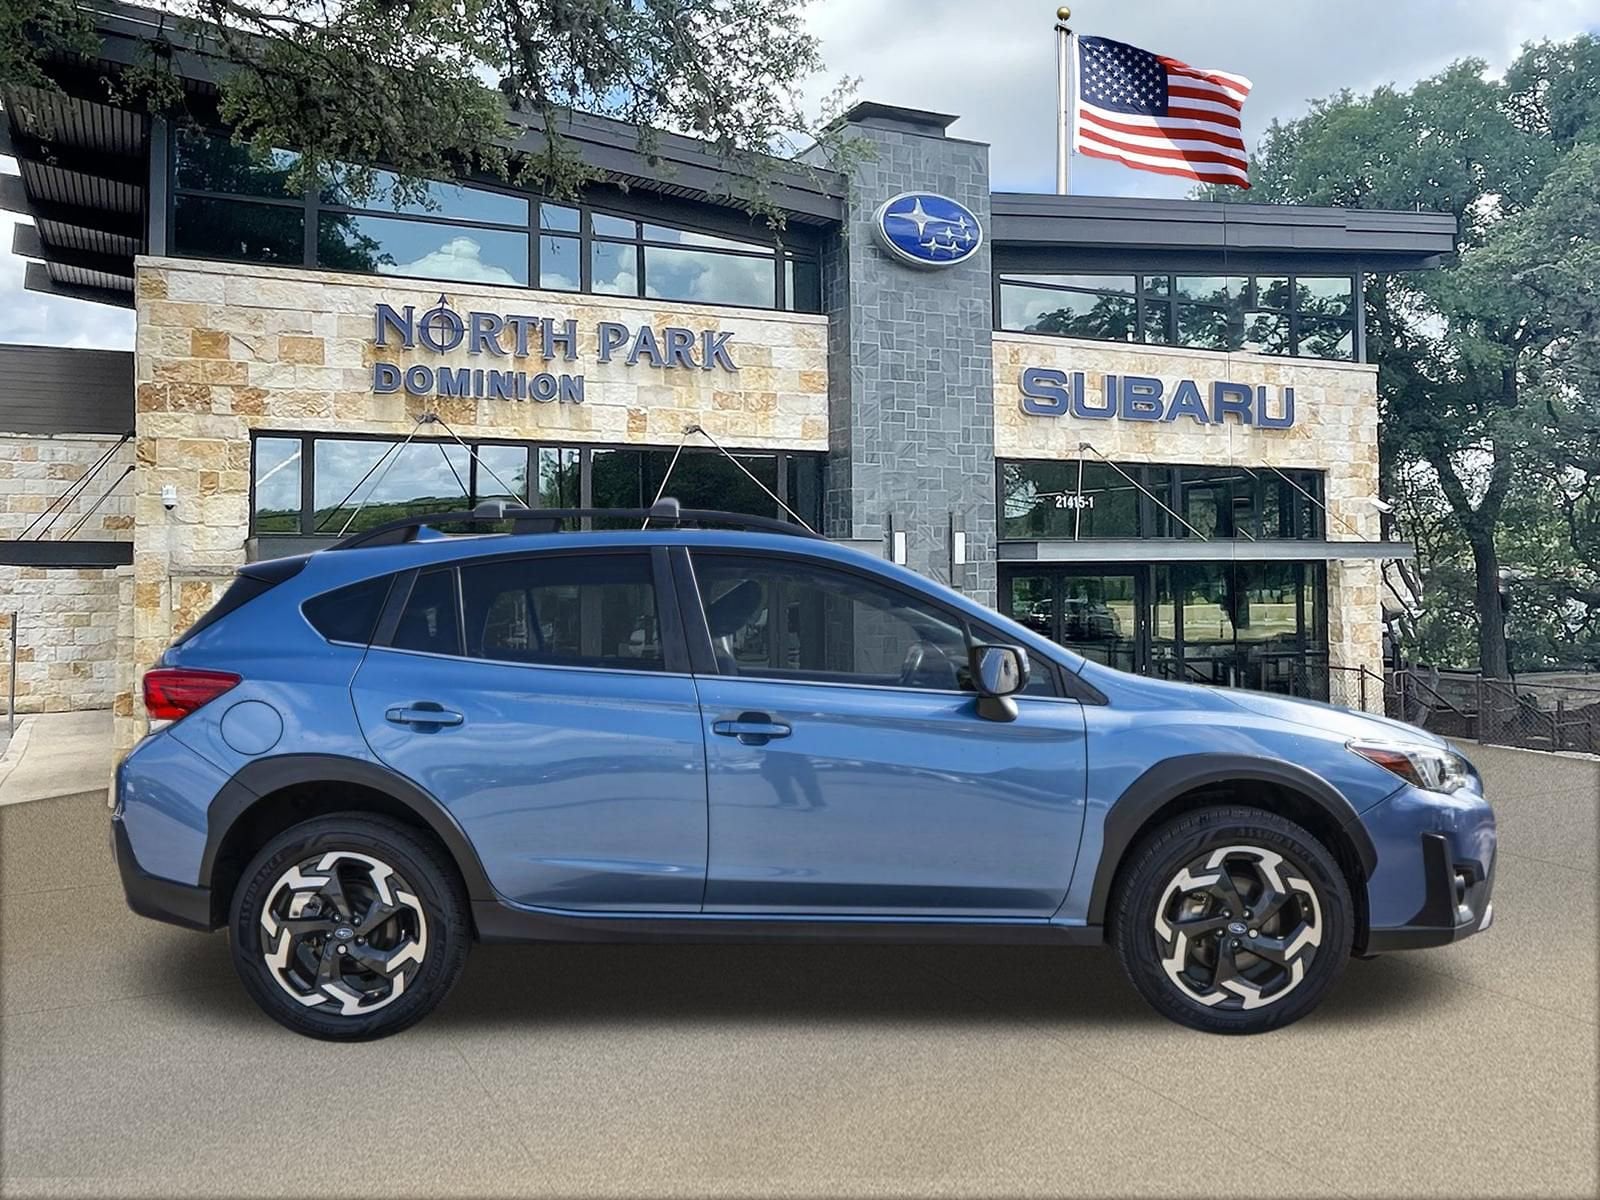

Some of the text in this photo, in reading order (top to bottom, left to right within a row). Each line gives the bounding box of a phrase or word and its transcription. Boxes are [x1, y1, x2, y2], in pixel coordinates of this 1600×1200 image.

[375, 293, 741, 373] NORTH PARK
[373, 363, 585, 404] DOMINION
[1019, 367, 1296, 430] SUBARU
